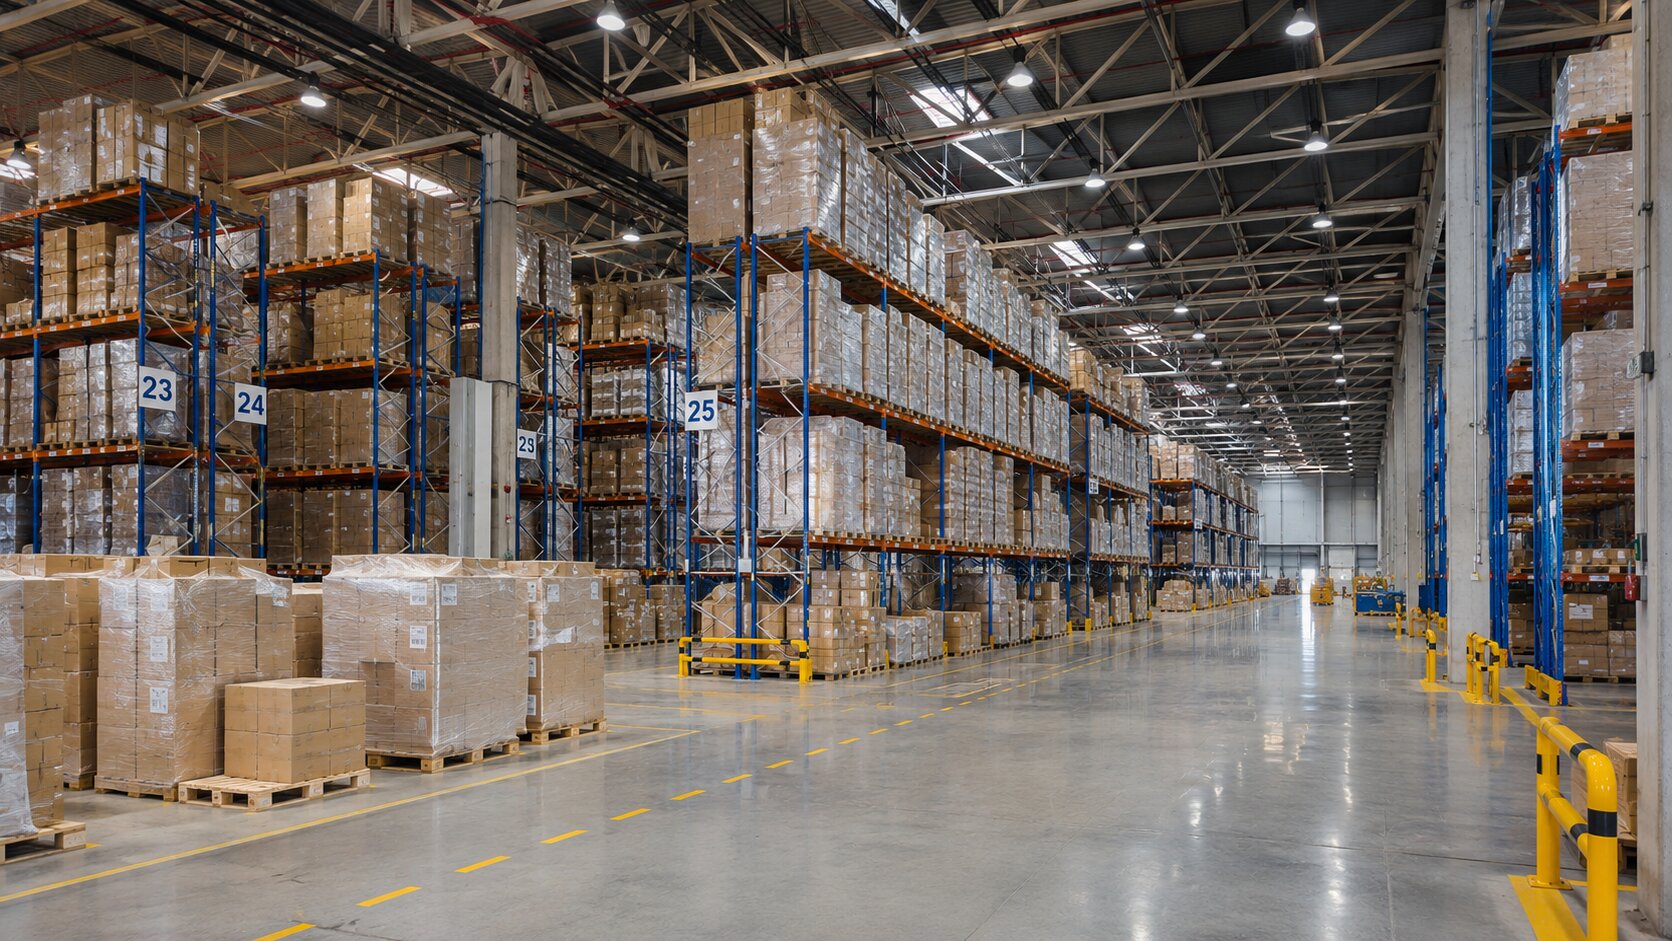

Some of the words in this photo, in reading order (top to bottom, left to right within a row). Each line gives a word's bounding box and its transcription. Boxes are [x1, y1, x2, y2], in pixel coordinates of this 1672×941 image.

[143, 376, 172, 401] 23
[238, 391, 264, 415] 24
[688, 399, 714, 422] 25
